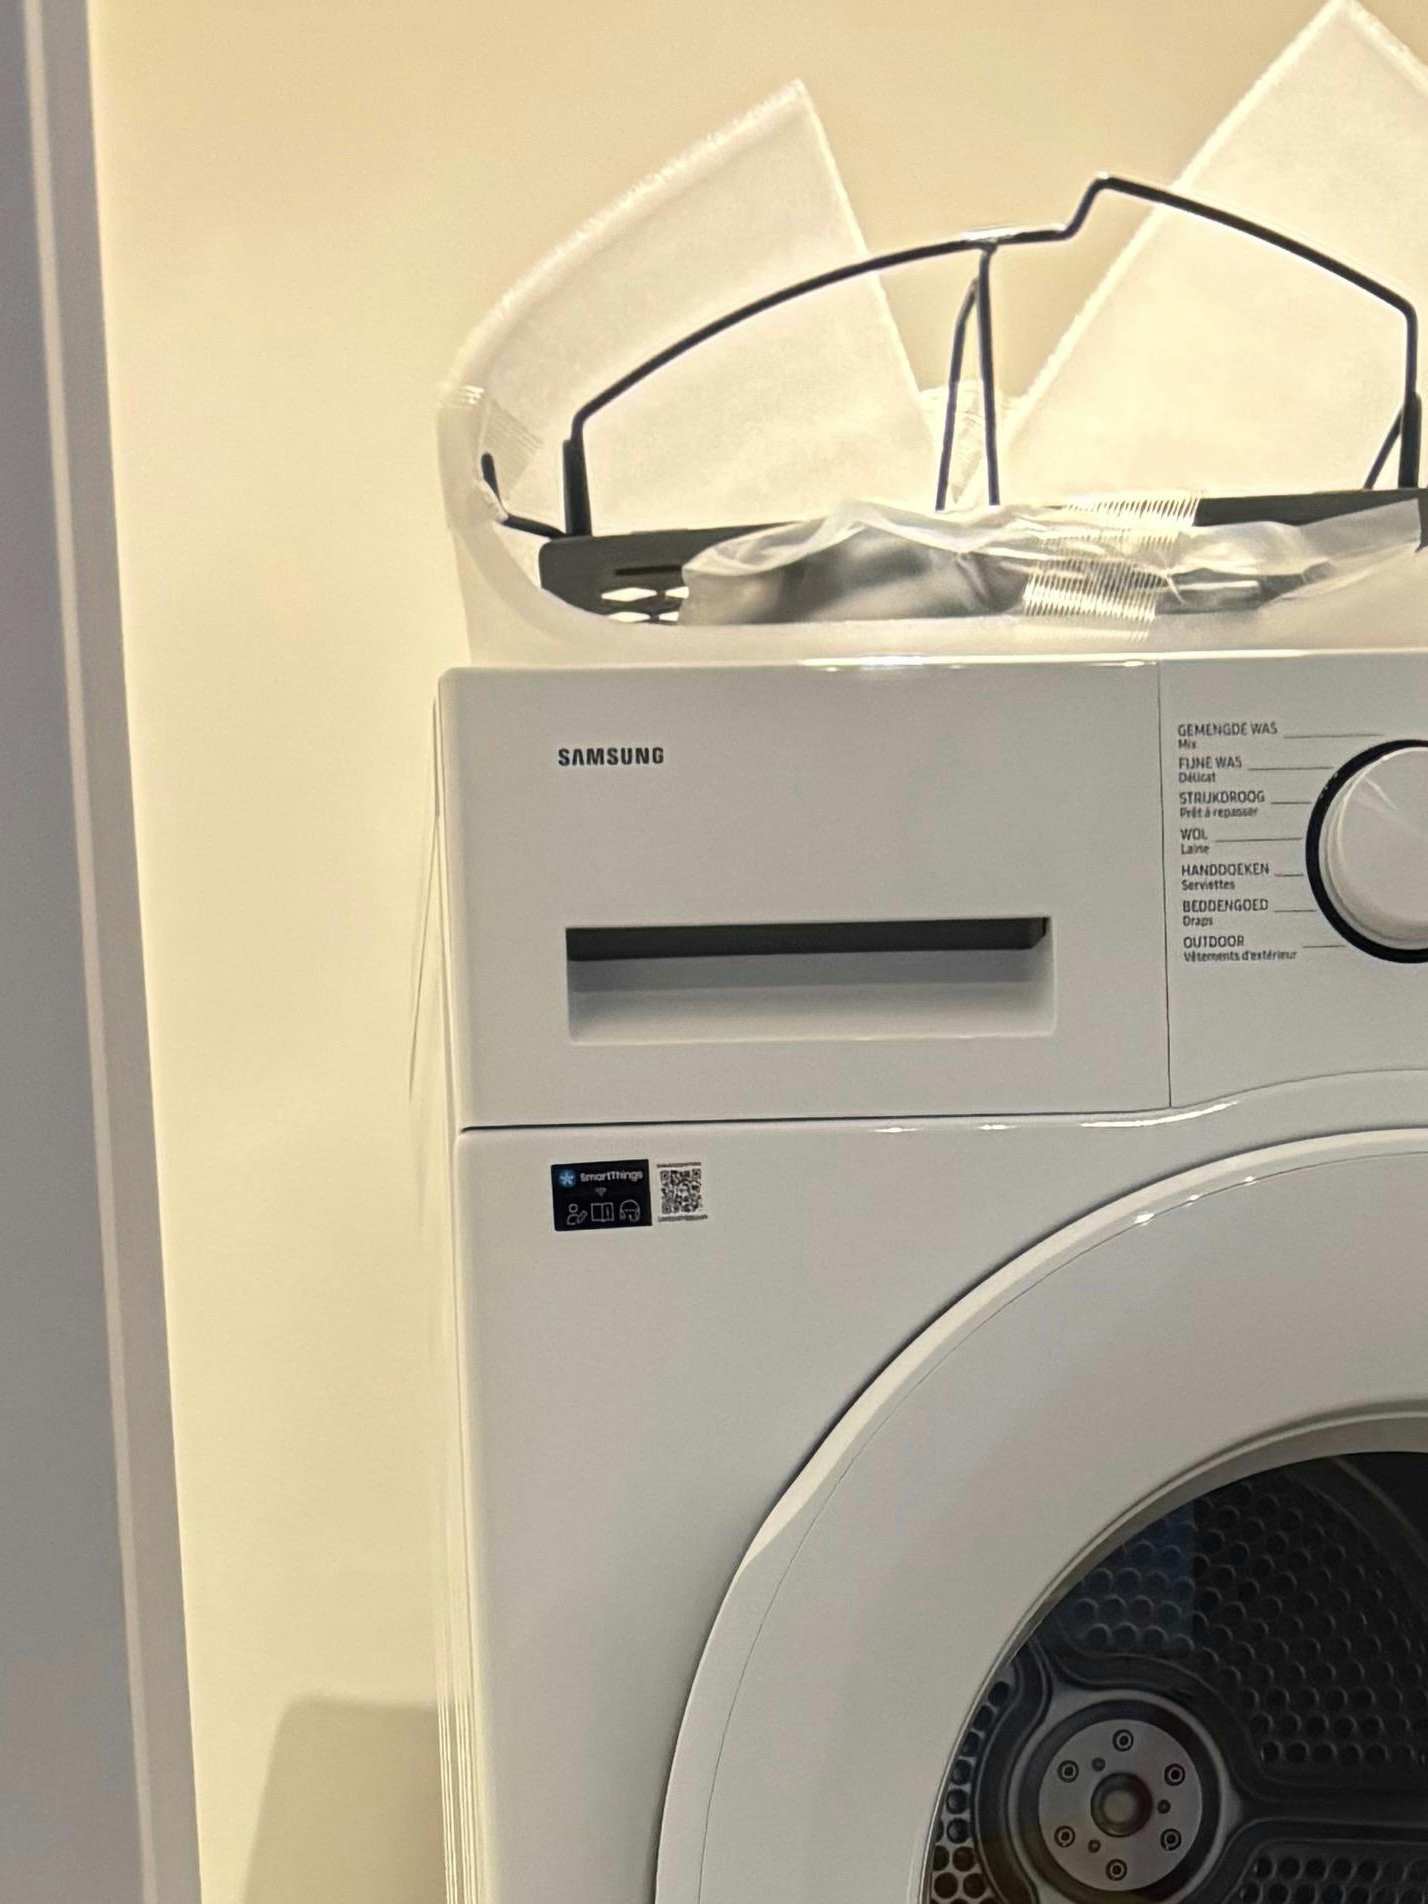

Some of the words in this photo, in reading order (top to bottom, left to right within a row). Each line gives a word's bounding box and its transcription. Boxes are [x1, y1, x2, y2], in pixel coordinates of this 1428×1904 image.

[1177, 722, 1248, 737] GEMENGDE
[1251, 720, 1278, 735] WAS
[557, 747, 665, 767] SAMSUNG
[1215, 755, 1243, 769] WAS
[1179, 790, 1266, 805] STRIJKDROOG
[1180, 828, 1208, 841] WOL
[1181, 862, 1270, 877] HANDDOEKEN
[1181, 879, 1236, 891] Serviettes
[1182, 898, 1269, 913] BEDDENGOED
[1183, 935, 1245, 949] OUTDOOR
